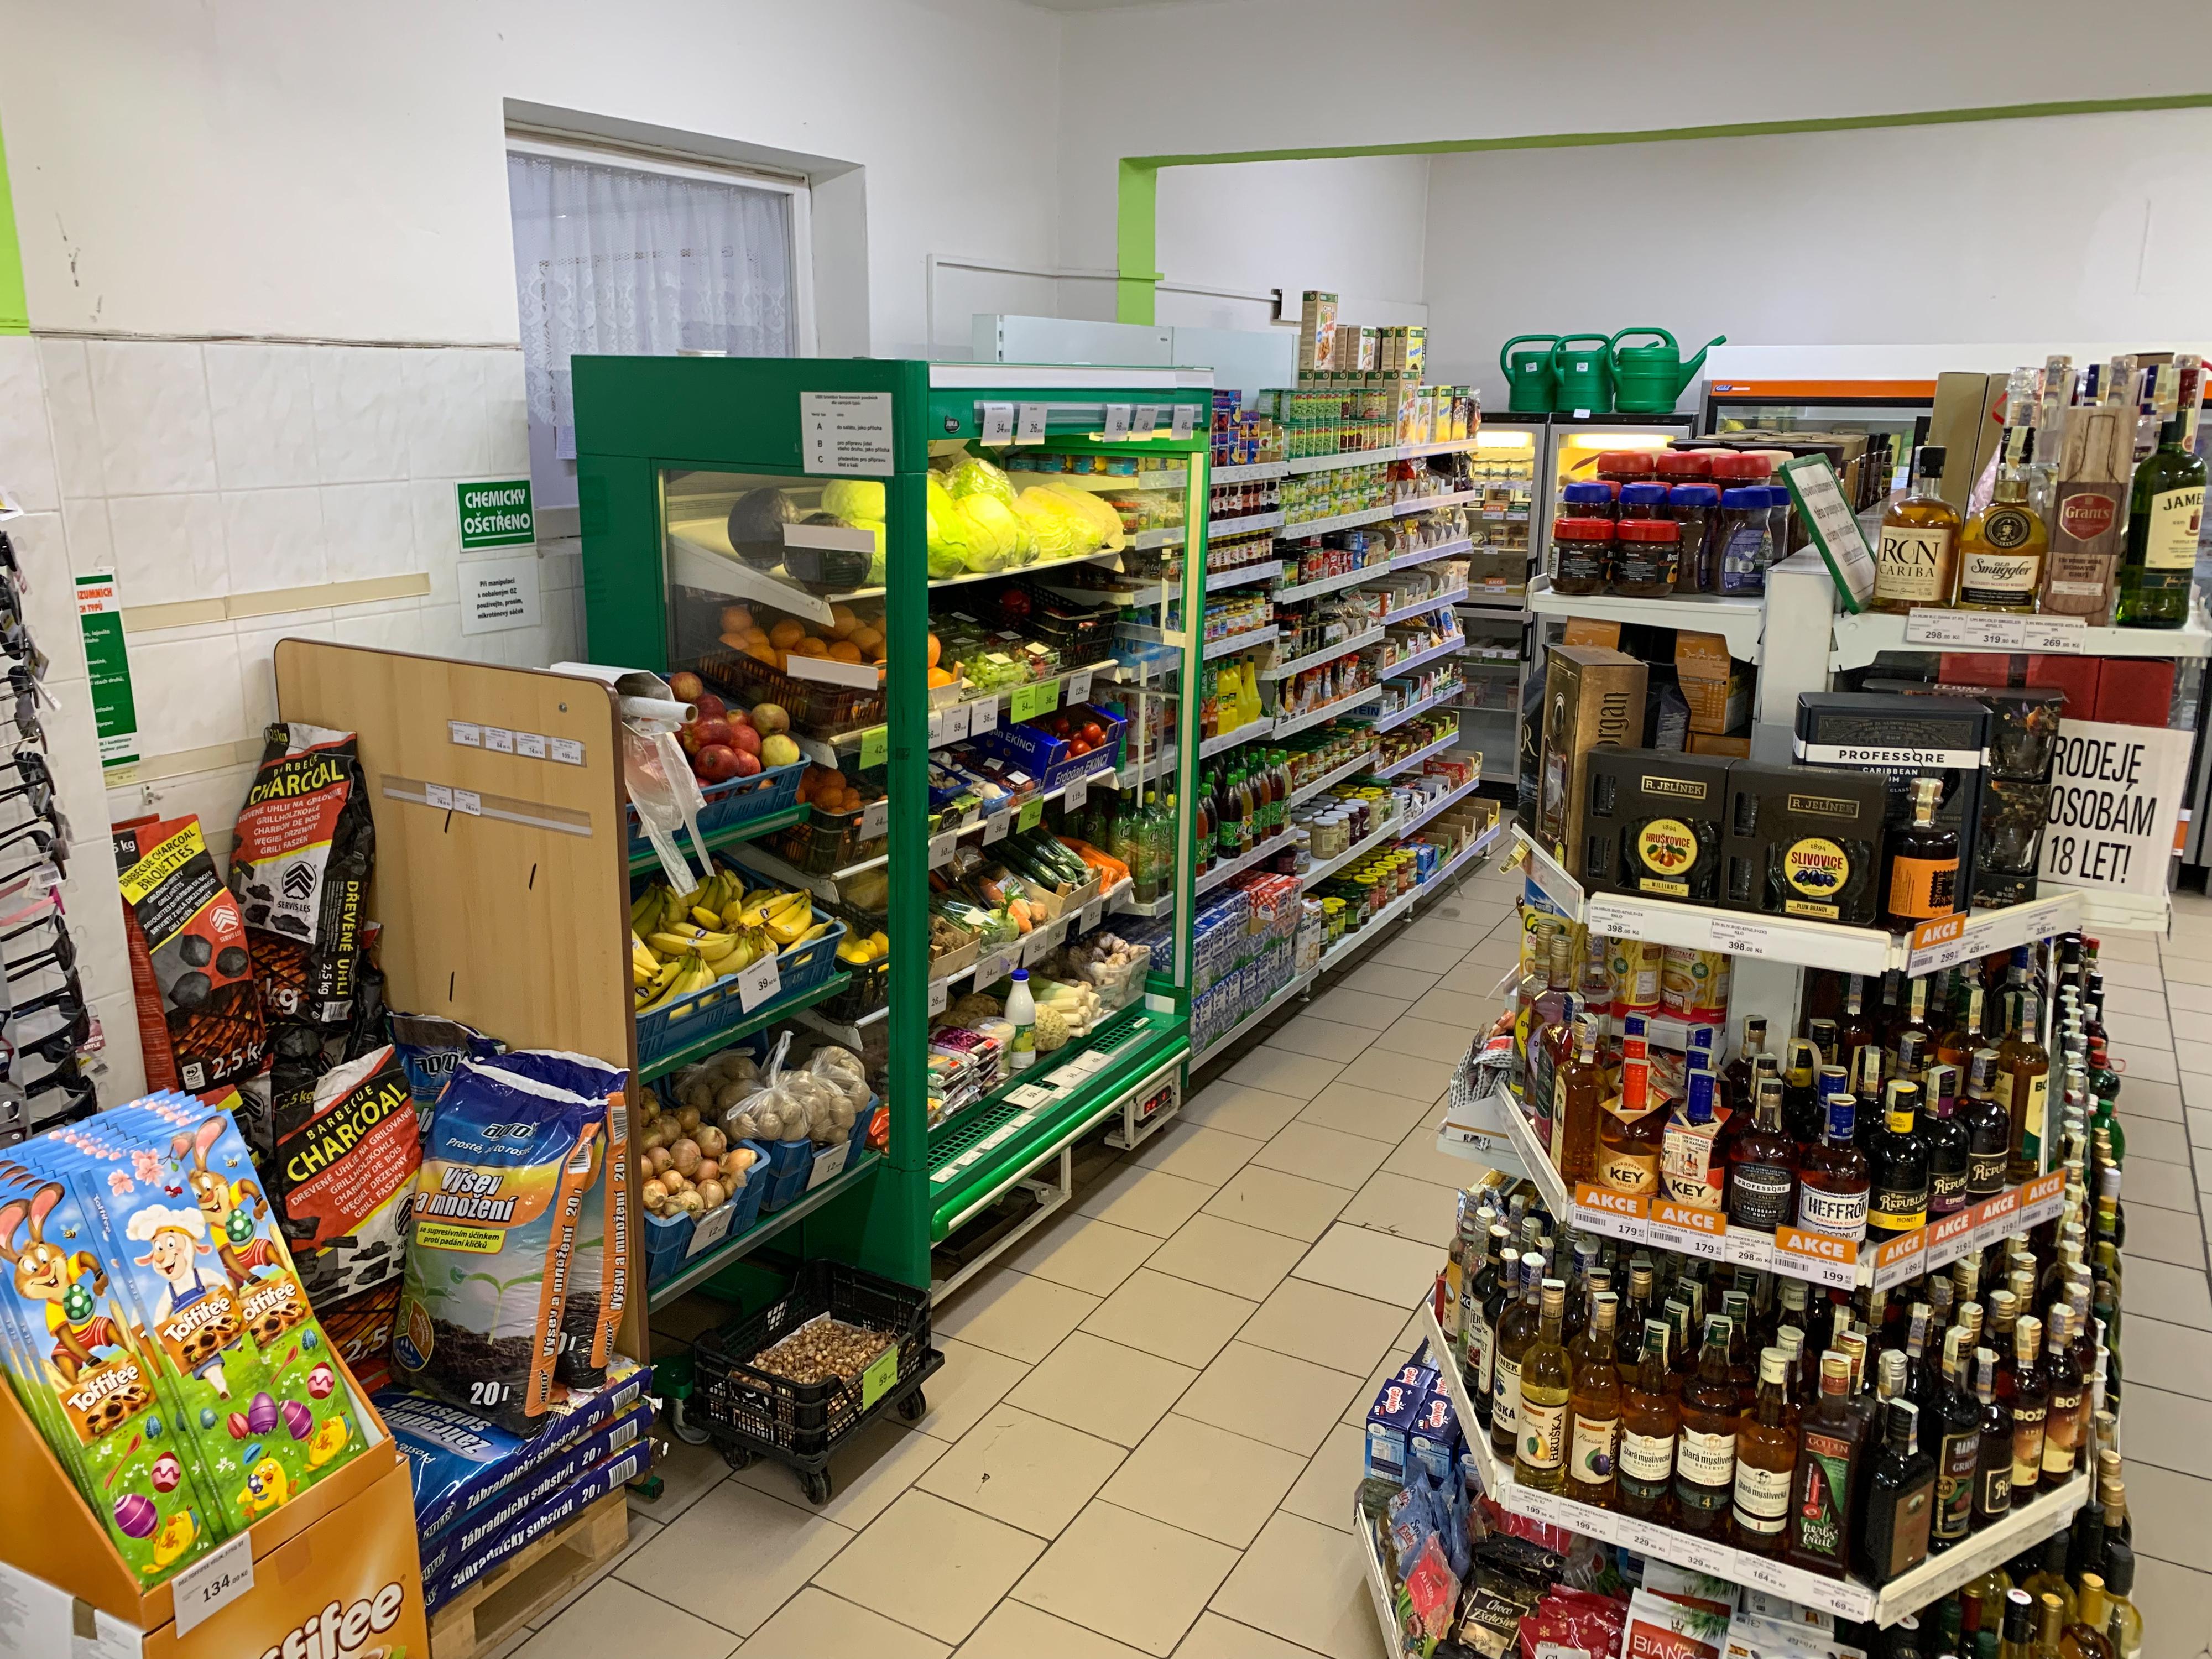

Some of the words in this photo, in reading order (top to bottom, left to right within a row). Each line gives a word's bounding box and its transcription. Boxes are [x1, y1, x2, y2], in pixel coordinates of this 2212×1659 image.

[465, 489, 525, 508] CHEMICKY
[464, 510, 531, 534] OŠETŘENO
[1880, 564, 1934, 578] CARIBA
[1971, 557, 2032, 581] Smuggler
[488, 577, 515, 587] manipulaci
[482, 589, 508, 598] nebaleným
[477, 611, 508, 619] mikroténový
[1839, 749, 1945, 763] PROFESSORE
[2054, 736, 2145, 784] RODEJE
[1862, 766, 1919, 776] CARIBBEAN
[250, 759, 345, 806] CHARCOAL
[1657, 782, 1702, 795] JELÍNEK
[1805, 799, 1854, 813] JELÍNEK
[2047, 783, 2157, 837] OSOBÁM
[293, 817, 302, 827] DE
[1662, 824, 1677, 832] 1894
[120, 839, 135, 852] kg
[260, 844, 281, 854] GRILL
[1646, 832, 1691, 848] HRUŠKOVICE
[1810, 843, 1827, 852] 1894
[119, 858, 154, 888] BARBECUE
[152, 830, 196, 860] CHARCOAL
[137, 844, 195, 891] BRIQUETTES
[1791, 851, 1844, 870] SLIVOVICE
[2049, 835, 2075, 875] 18
[2080, 839, 2132, 884] LET!
[1651, 881, 1678, 890] WILLIAMS
[278, 900, 299, 911] SERVIS
[300, 904, 310, 912] LES
[338, 880, 360, 952] DŘEVĚNÉ
[1922, 921, 1958, 944] AKCE
[1940, 952, 1954, 962] 299
[336, 958, 351, 995] UHLÍ
[318, 982, 332, 995] kg
[212, 1048, 243, 1080] 2,5
[306, 1085, 374, 1140] BARBECUE
[286, 1082, 408, 1182] CHARCOAL
[446, 1137, 482, 1155] Prostě,
[291, 1173, 334, 1206] DREVENÉ
[335, 1157, 359, 1177] UHLIE
[358, 1145, 369, 1158] NA
[369, 1106, 414, 1145] GRILOVANIE
[330, 1136, 396, 1194] GRILLHOLZKOHLE
[334, 1171, 372, 1206] CHARBON
[372, 1160, 384, 1173] DE
[384, 1145, 403, 1162] BOIS
[441, 1166, 504, 1196] Výsev
[613, 1161, 625, 1182] 20
[1610, 1167, 1645, 1184] KEY
[340, 1188, 370, 1215] WĘGIEL
[370, 1154, 408, 1190] DRZEWNY
[1616, 1181, 1636, 1190] SPICED
[1672, 1179, 1707, 1198] KEY
[1738, 1178, 1786, 1192] PROFESSORE
[2028, 1177, 2061, 1201] AKCE
[354, 1198, 376, 1218] GRILL
[375, 1171, 405, 1199] FASZÉN
[1585, 1191, 1637, 1214] AKCE
[415, 1192, 430, 1213] a
[427, 1193, 519, 1223] množení
[565, 1195, 581, 1217] 20
[1743, 1204, 1777, 1214] CARIBBEAN
[1808, 1196, 1867, 1220] HEFFRON
[1983, 1194, 2015, 1220] AKCE
[614, 1191, 625, 1254] množení
[1662, 1207, 1715, 1230] AKCE
[1816, 1217, 1843, 1225] PANAMA
[1935, 1214, 1969, 1241] AKCE
[427, 1227, 468, 1239] supresivním
[468, 1229, 499, 1241] účinkem
[1618, 1224, 1637, 1236] 179
[2001, 1224, 2013, 1235] 219
[424, 1235, 440, 1245] proti
[441, 1237, 463, 1247] padání
[465, 1239, 487, 1249] klíčků
[1695, 1242, 1714, 1254] 179
[1787, 1234, 1845, 1259] AKCE
[1885, 1235, 1919, 1262] AKCE
[1955, 1243, 1968, 1255] 219
[553, 1225, 574, 1292] množení
[615, 1255, 625, 1266] a
[1822, 1270, 1844, 1282] 199
[1904, 1263, 1917, 1276] 199
[609, 1267, 625, 1310] Výsev
[242, 1282, 296, 1324] offifee
[551, 1292, 561, 1306] a
[163, 1296, 231, 1344] Toffifee
[542, 1310, 559, 1358] Výsev
[346, 1329, 387, 1362] 2,5
[66, 1364, 140, 1413] Toffifee
[470, 1381, 500, 1406] 20
[1386, 1386, 1402, 1413] GRANKO
[586, 1410, 600, 1428] 20
[1430, 1401, 1447, 1428] GRANKO
[1521, 1415, 1545, 1431] Premium
[1548, 1412, 1564, 1463] HRUŠKA
[1575, 1432, 1605, 1446] Premium
[1808, 1437, 1849, 1455] GOLDEN
[582, 1447, 597, 1466] 20
[1623, 1446, 1638, 1459] Stará
[1638, 1453, 1670, 1463] myslivecká
[1681, 1446, 1700, 1462] Stará
[1633, 1460, 1659, 1469] RESERVE
[1694, 1463, 1725, 1471] RESERVE
[581, 1485, 596, 1504] 20
[1640, 1488, 1648, 1496] 4
[1738, 1478, 1751, 1494] Stará
[1751, 1488, 1787, 1500] myslivecká
[460, 1491, 529, 1552] Záhradnícky
[531, 1460, 575, 1501] substrát
[1702, 1497, 1712, 1507] 4
[451, 1528, 525, 1590] Záhradnícky
[526, 1499, 573, 1539] substrát
[1486, 1599, 1514, 1615] Choco
[1468, 1608, 1519, 1629] Exclusive
